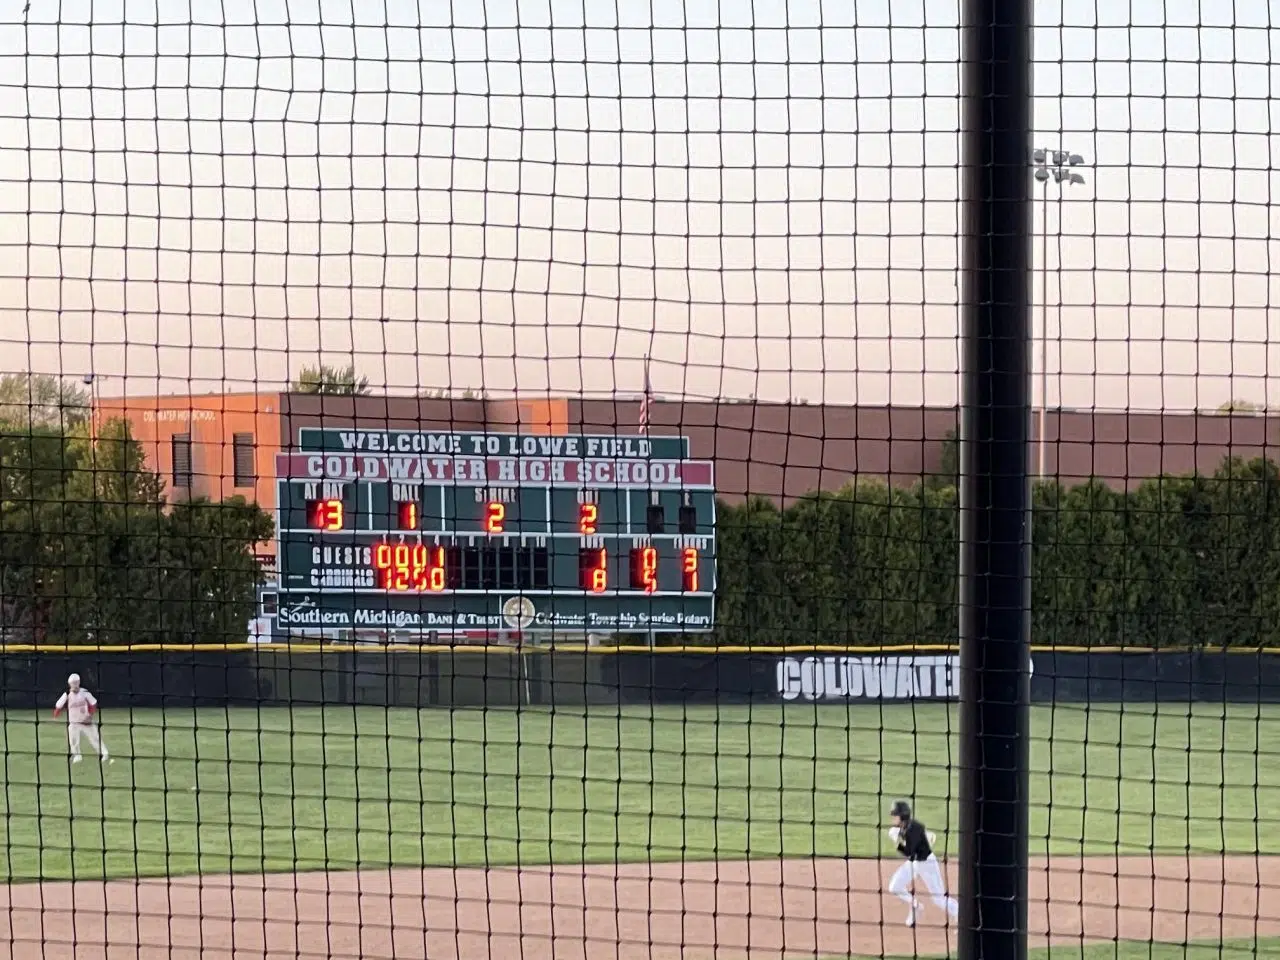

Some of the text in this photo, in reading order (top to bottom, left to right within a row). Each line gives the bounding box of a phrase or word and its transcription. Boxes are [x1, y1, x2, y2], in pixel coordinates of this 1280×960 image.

[143, 410, 177, 422] COLWATER
[340, 432, 651, 457] WELCOME TO LOWE FIELD
[307, 456, 681, 483] COLDWATER HIGH SCHOOL
[304, 483, 317, 500] AT
[392, 484, 419, 501] BALL
[409, 503, 416, 530] 1
[488, 502, 505, 533] 2
[580, 504, 597, 534] 2
[312, 546, 372, 565] GUESTS
[643, 548, 657, 570] 0
[684, 548, 698, 572] 3
[310, 568, 374, 587] CARDINALS
[593, 569, 607, 592] 8
[280, 608, 349, 624] Southern
[354, 609, 424, 628] Michigan
[456, 613, 466, 625] &
